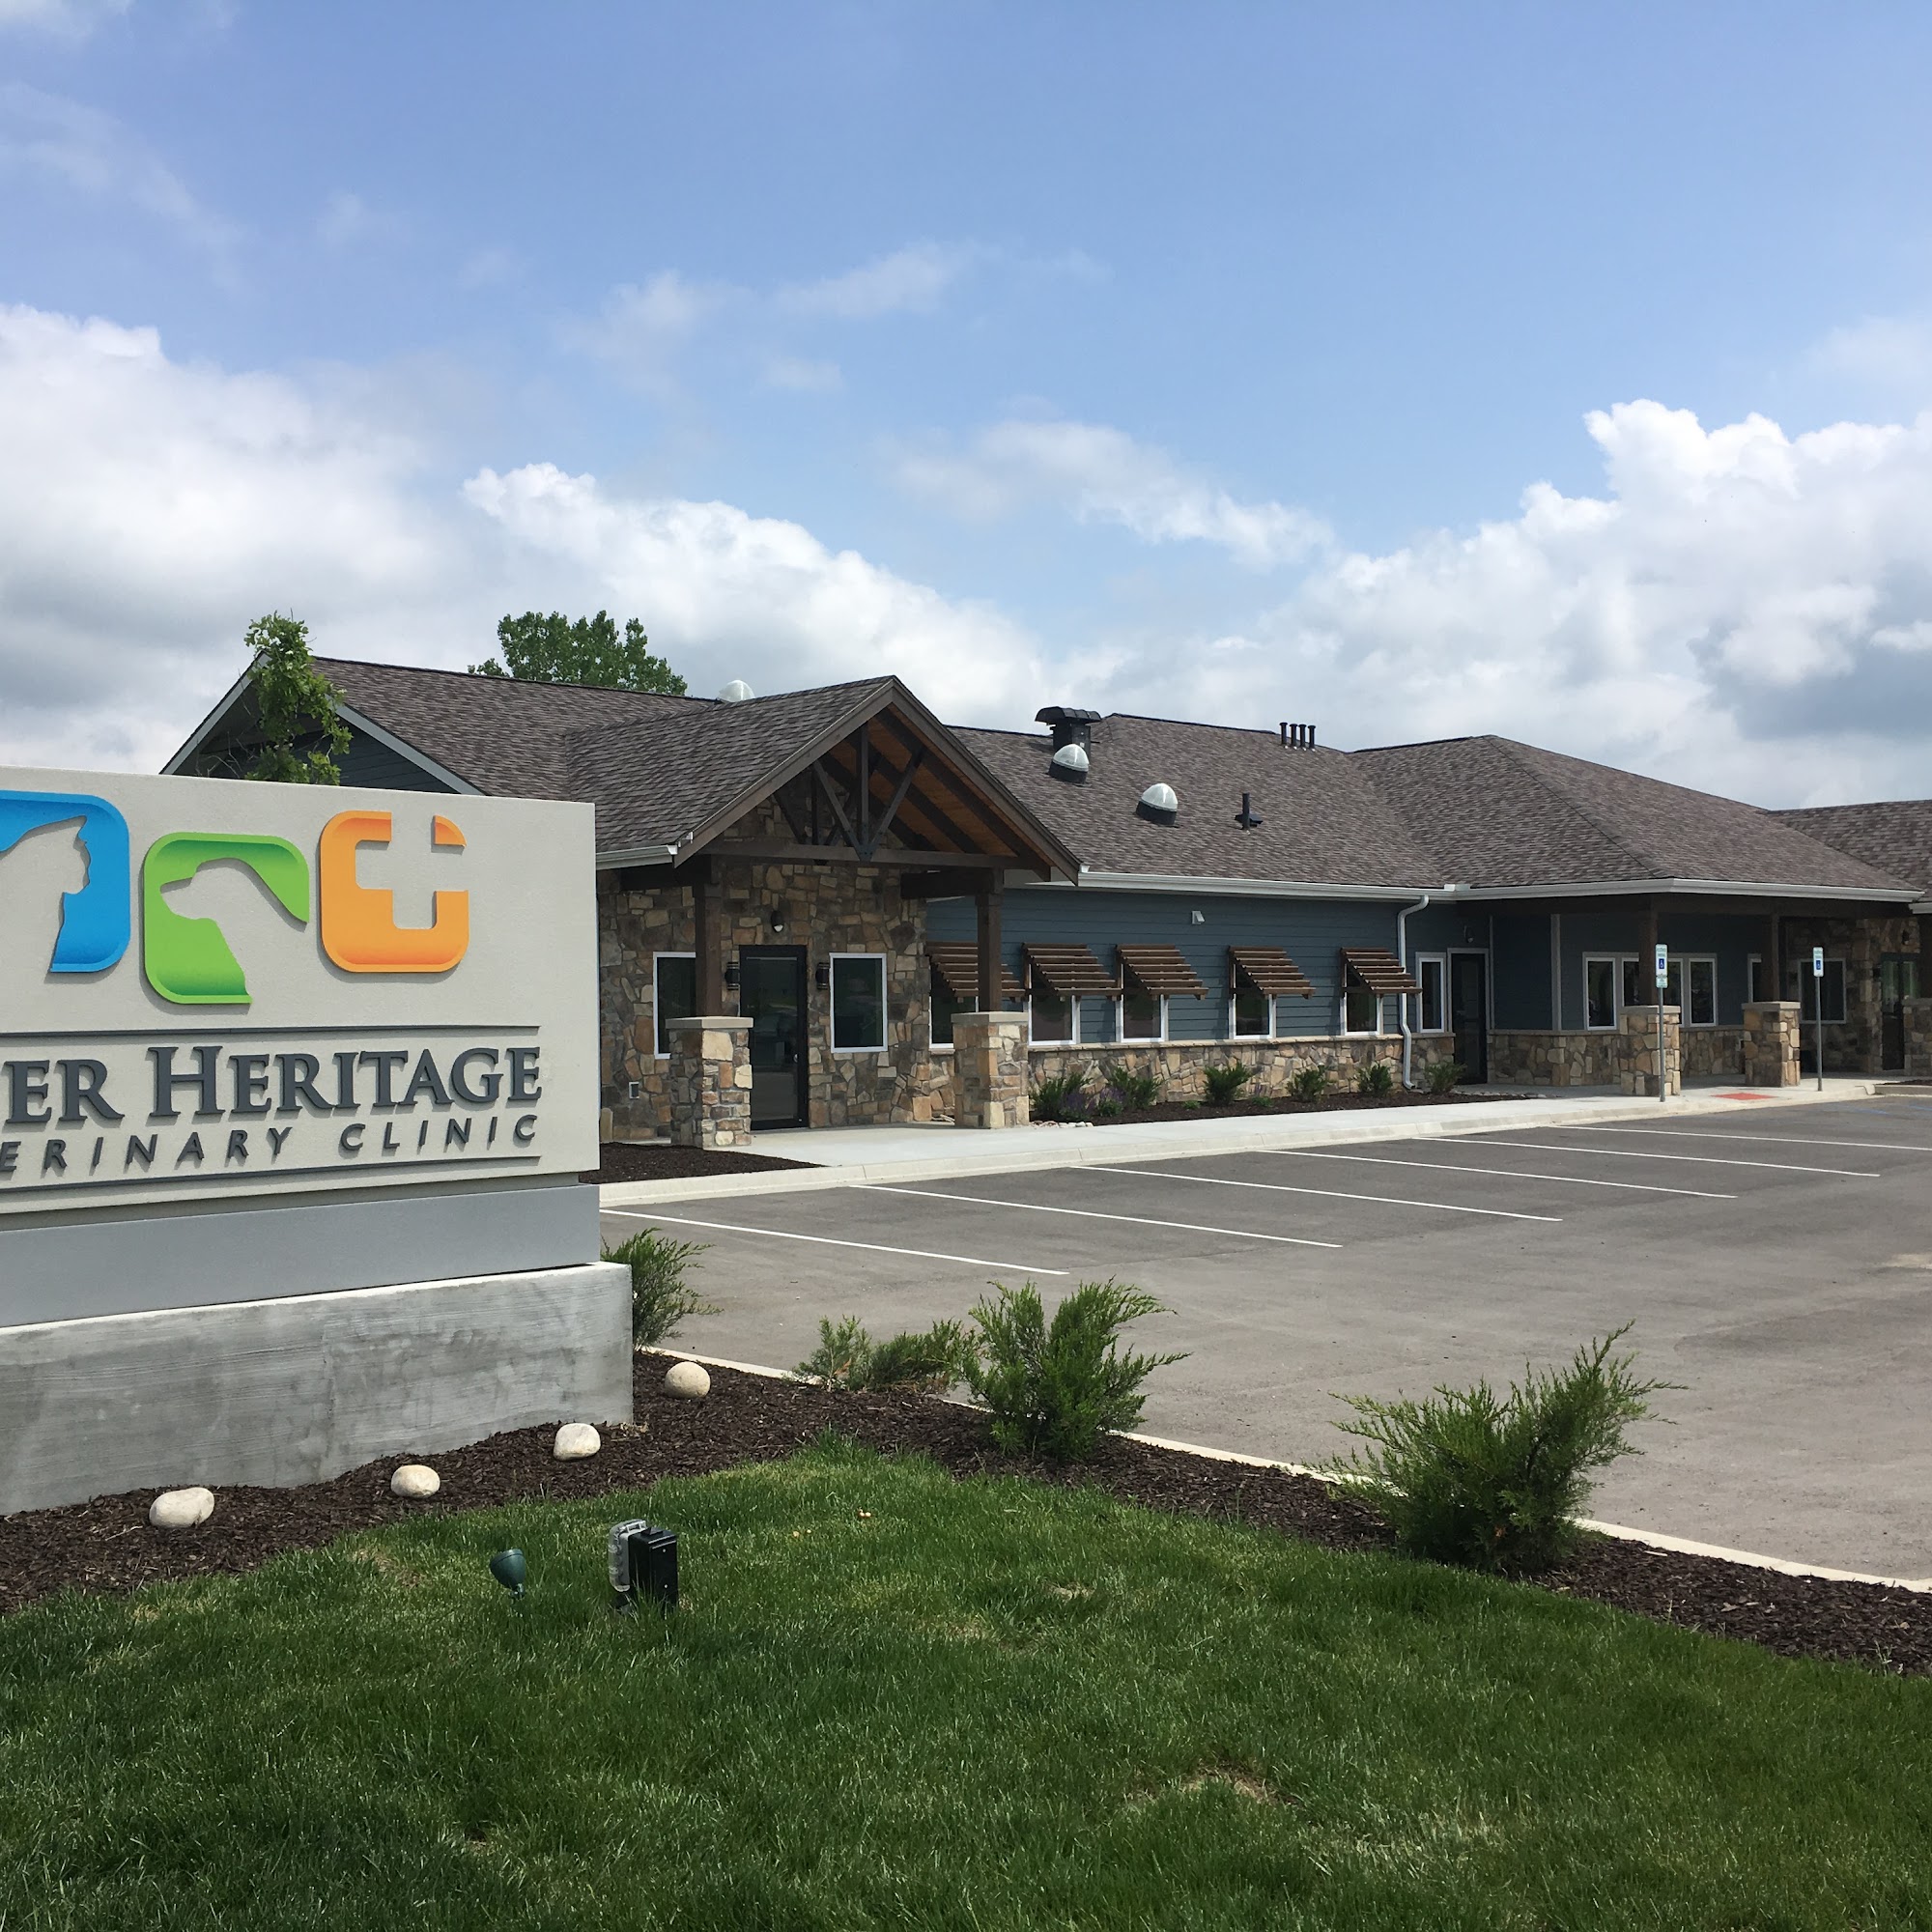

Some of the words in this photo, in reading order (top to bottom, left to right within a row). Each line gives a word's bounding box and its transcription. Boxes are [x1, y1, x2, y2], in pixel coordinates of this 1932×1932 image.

[4, 1059, 126, 1123] ER
[147, 1045, 543, 1117] HERITAGE
[0, 1126, 293, 1172] ERINARY
[339, 1114, 538, 1151] CLINIC
